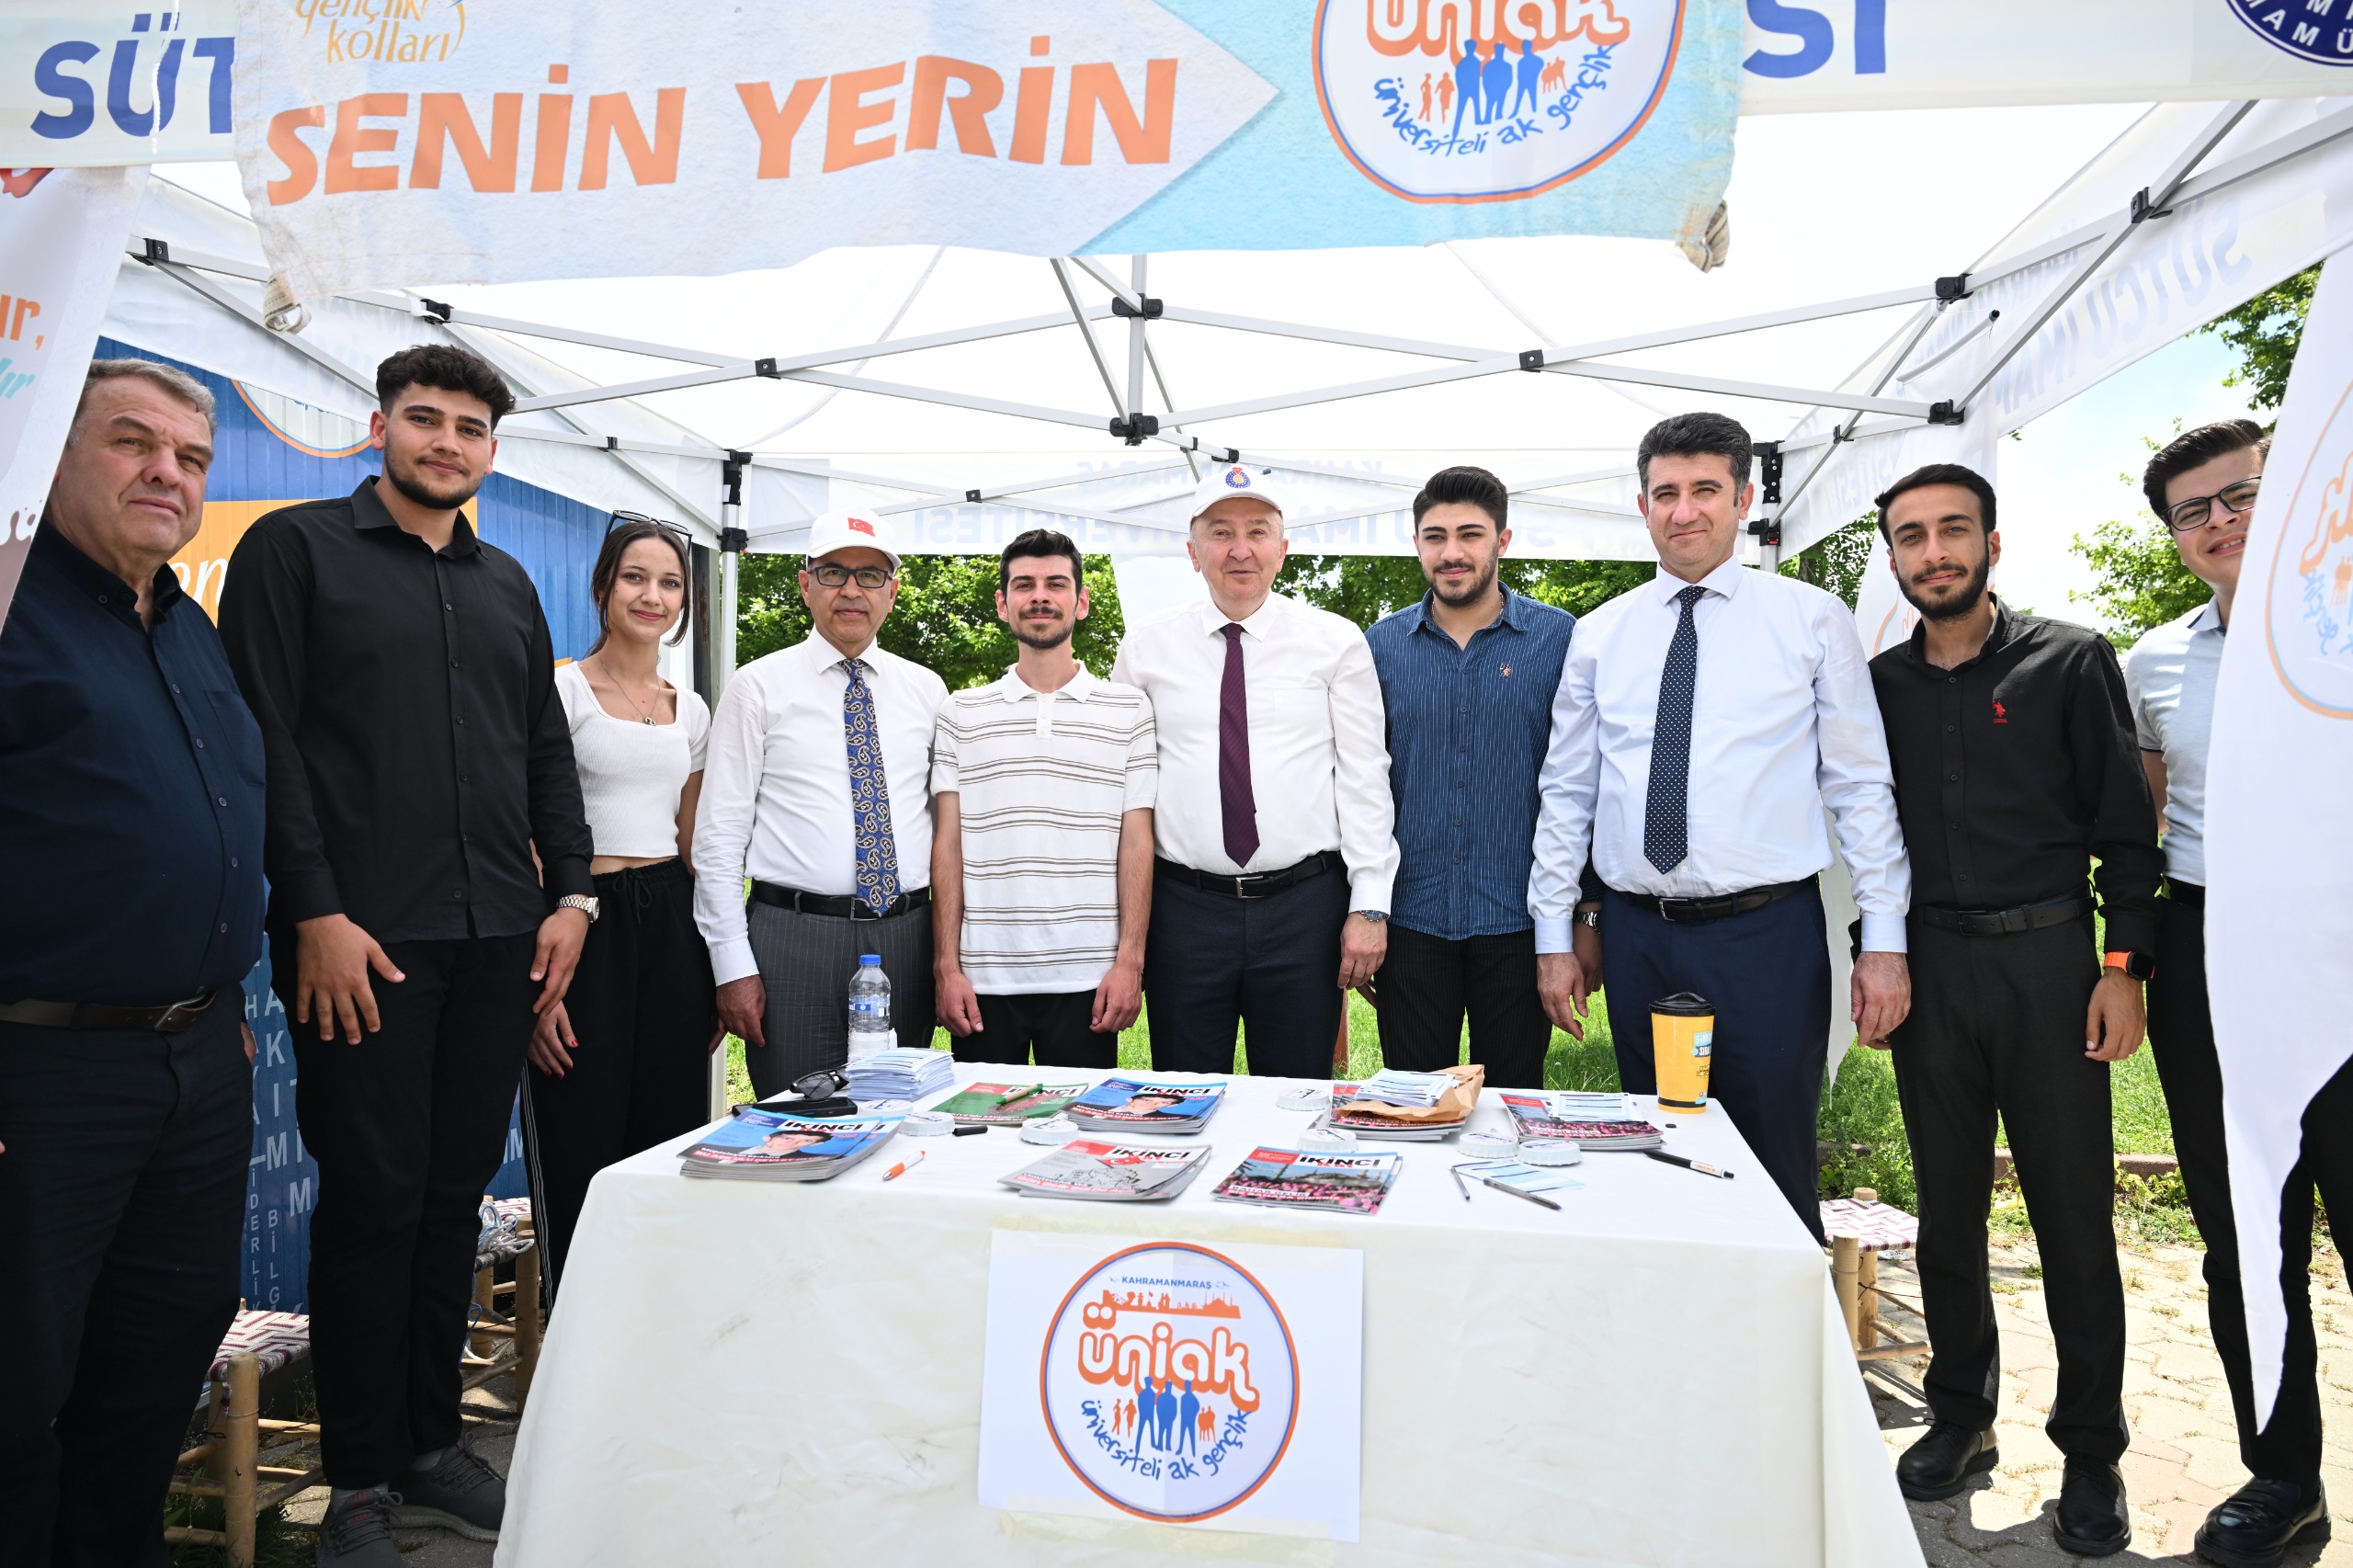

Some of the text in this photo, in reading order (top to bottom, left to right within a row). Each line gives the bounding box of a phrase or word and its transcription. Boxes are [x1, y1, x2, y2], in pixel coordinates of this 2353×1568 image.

[327, 18, 450, 64] kolları
[267, 35, 1178, 206] SENİN YERİN
[1496, 119, 1543, 144] ak
[1547, 42, 1620, 131] gençlik
[1121, 1275, 1212, 1290] KAHRAMANMARAŞ
[1078, 1301, 1260, 1413] üniak
[1081, 1399, 1253, 1481] üniversiteli ak gençlik
